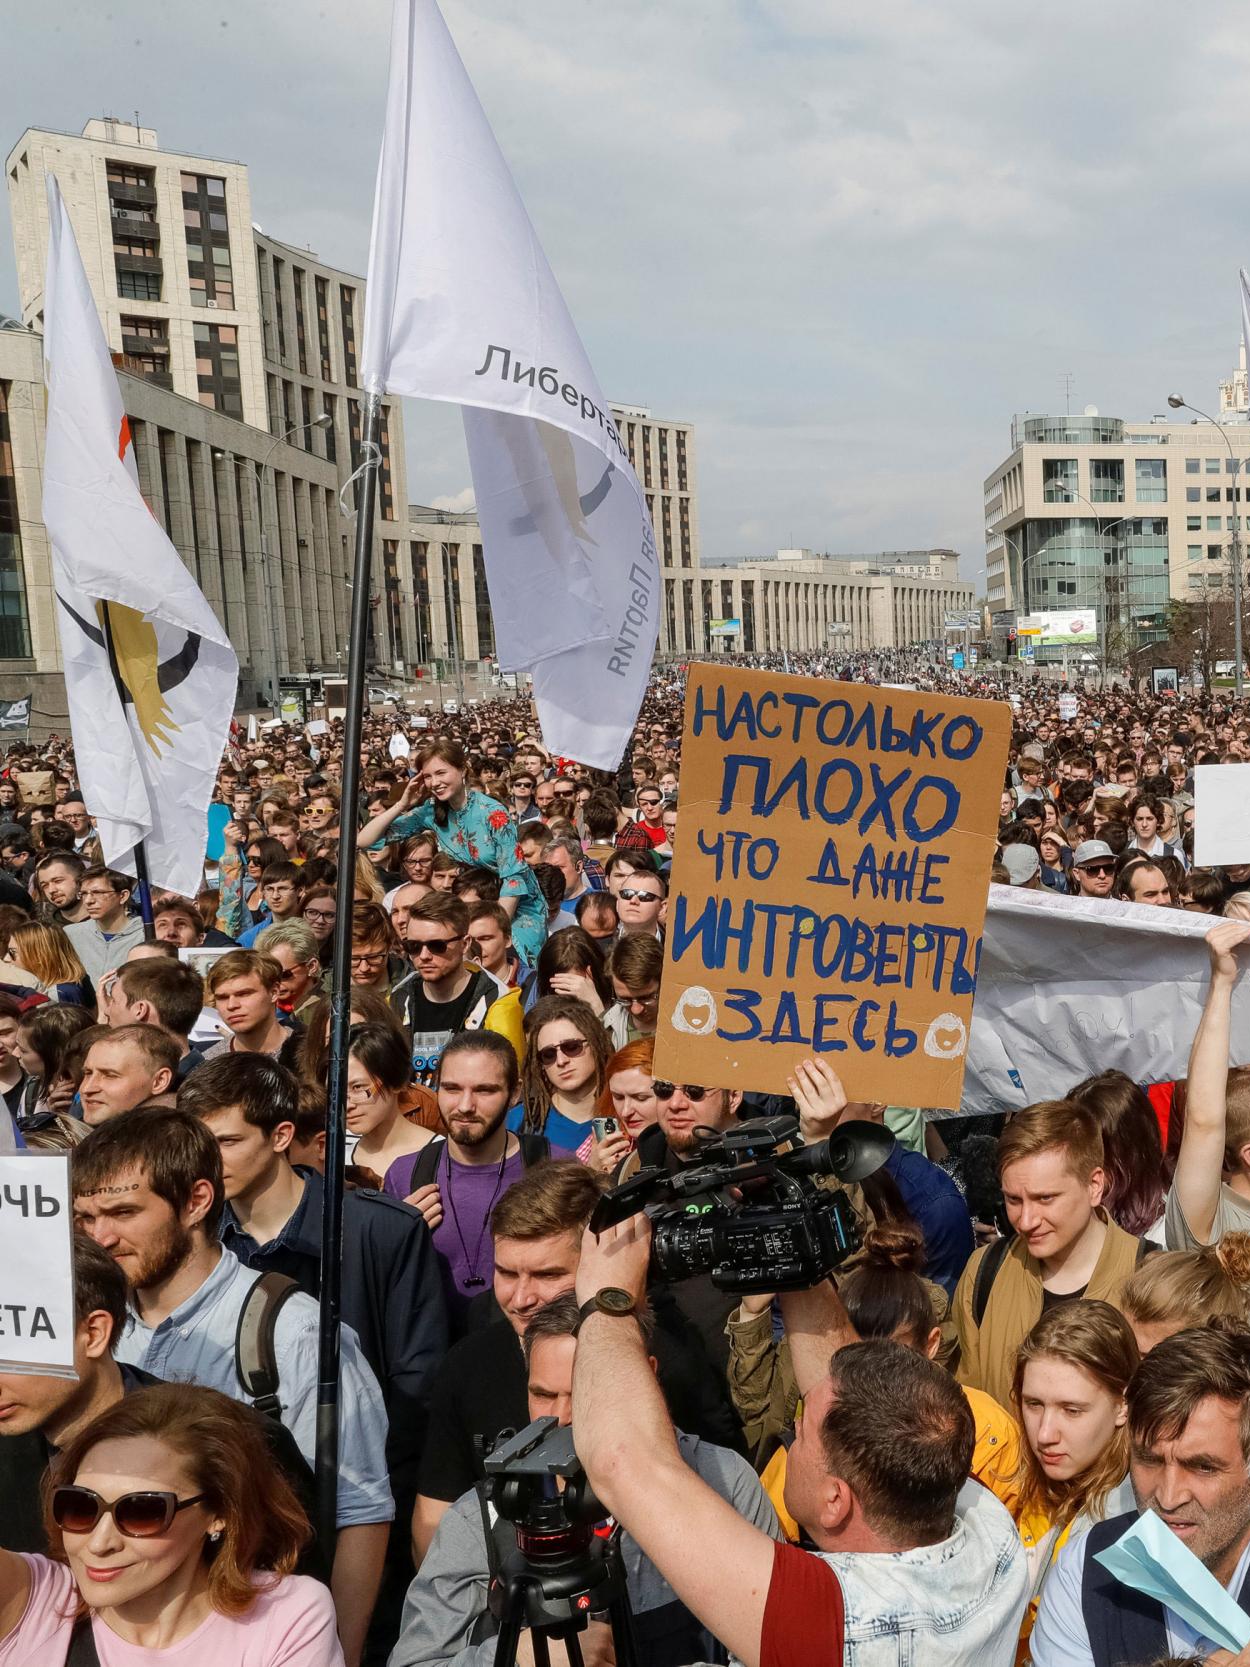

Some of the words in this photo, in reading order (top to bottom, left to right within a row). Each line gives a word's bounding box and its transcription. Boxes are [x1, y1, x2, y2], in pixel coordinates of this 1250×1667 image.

[693, 685, 983, 760] НАСТОЛЬКО
[717, 754, 960, 843] ПЛОХО
[697, 829, 779, 882] ЧТО
[806, 838, 950, 904] ДАЖЕ
[672, 894, 982, 1002] ИНТРОВЕРТЫ
[716, 988, 918, 1058] ЗДЕСЬ
[0, 1184, 60, 1218] ЧЬ
[783, 1202, 801, 1210] SONY
[0, 1304, 57, 1340] ТА
